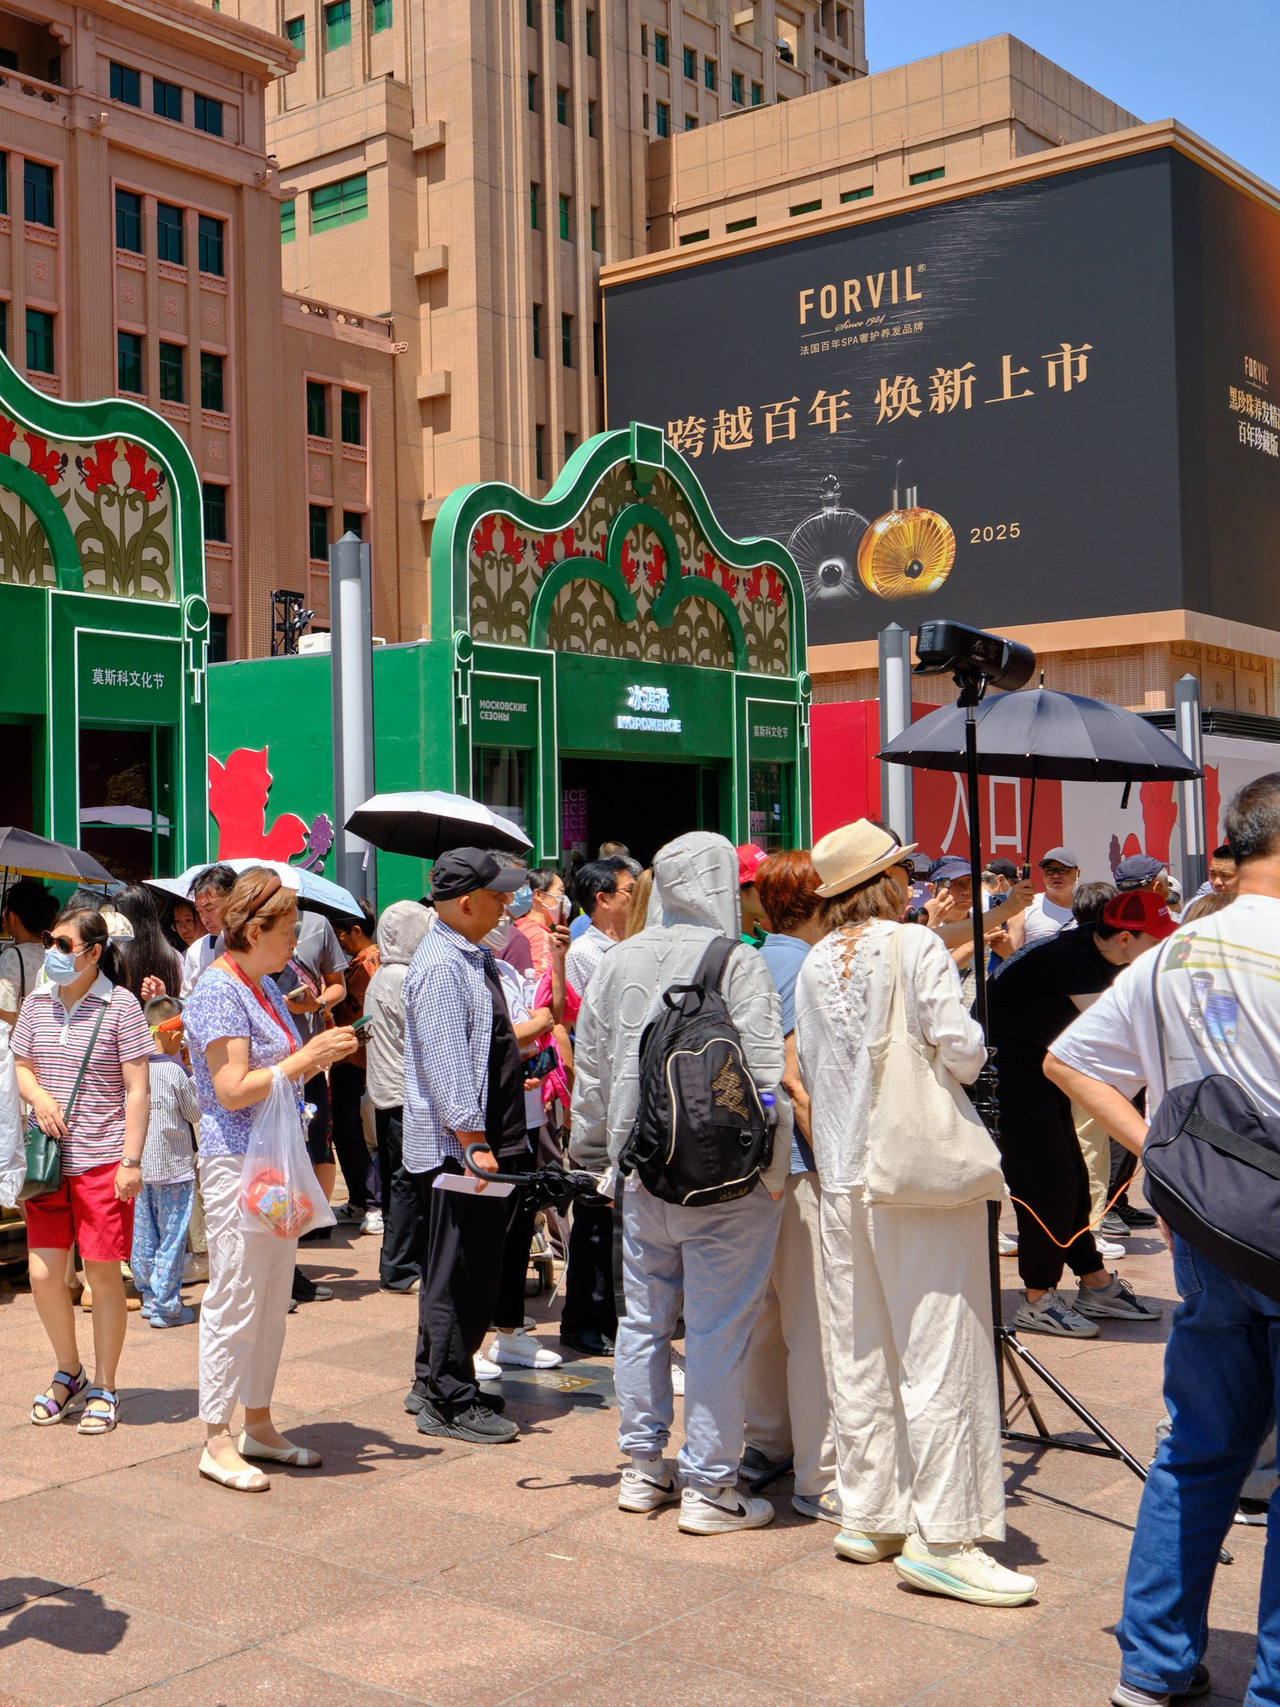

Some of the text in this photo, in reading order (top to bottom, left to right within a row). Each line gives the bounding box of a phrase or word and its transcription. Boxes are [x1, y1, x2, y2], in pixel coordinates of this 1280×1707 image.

[800, 266, 922, 324] FORVIL
[835, 314, 886, 333] Since 1924
[1244, 355, 1269, 385] FORVIL
[666, 343, 1093, 459] 跨越百年 焕新上市
[1228, 385, 1280, 431] 黑珍珠养发精
[1238, 420, 1279, 457] 百年珍藏版
[970, 522, 1020, 543] 2025
[92, 668, 165, 690] 莫斯科文化节
[479, 699, 528, 712] МОСКОВСКИЕ
[480, 711, 510, 721] СЕЗОНЫ
[617, 715, 682, 732] МОРОЖЕНОЕ
[561, 789, 587, 801] ICE
[561, 803, 587, 815] ICE
[940, 771, 1023, 854] 入口
[561, 817, 587, 829] ICE
